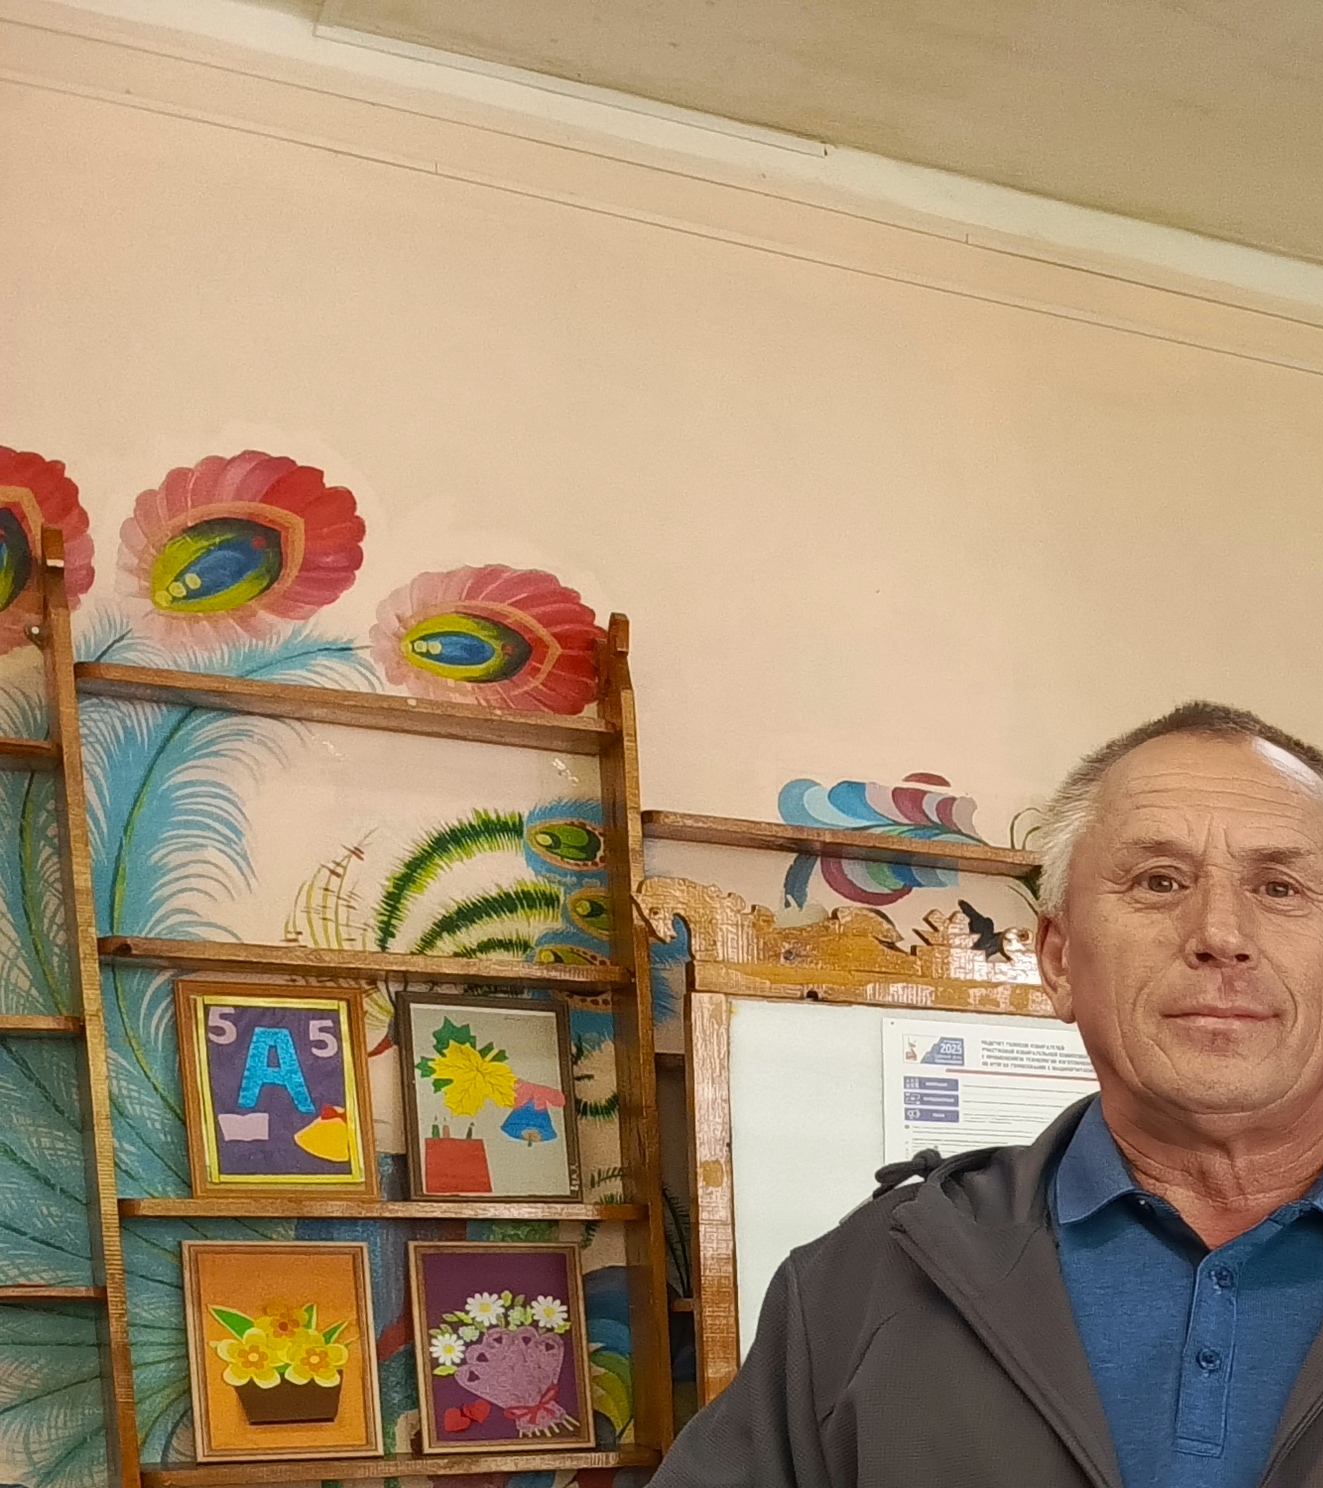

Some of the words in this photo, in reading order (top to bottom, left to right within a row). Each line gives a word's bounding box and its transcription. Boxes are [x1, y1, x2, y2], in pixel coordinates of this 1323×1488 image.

[208, 1006, 237, 1045] 5
[309, 1019, 338, 1058] 5
[940, 1043, 962, 1055] 2025
